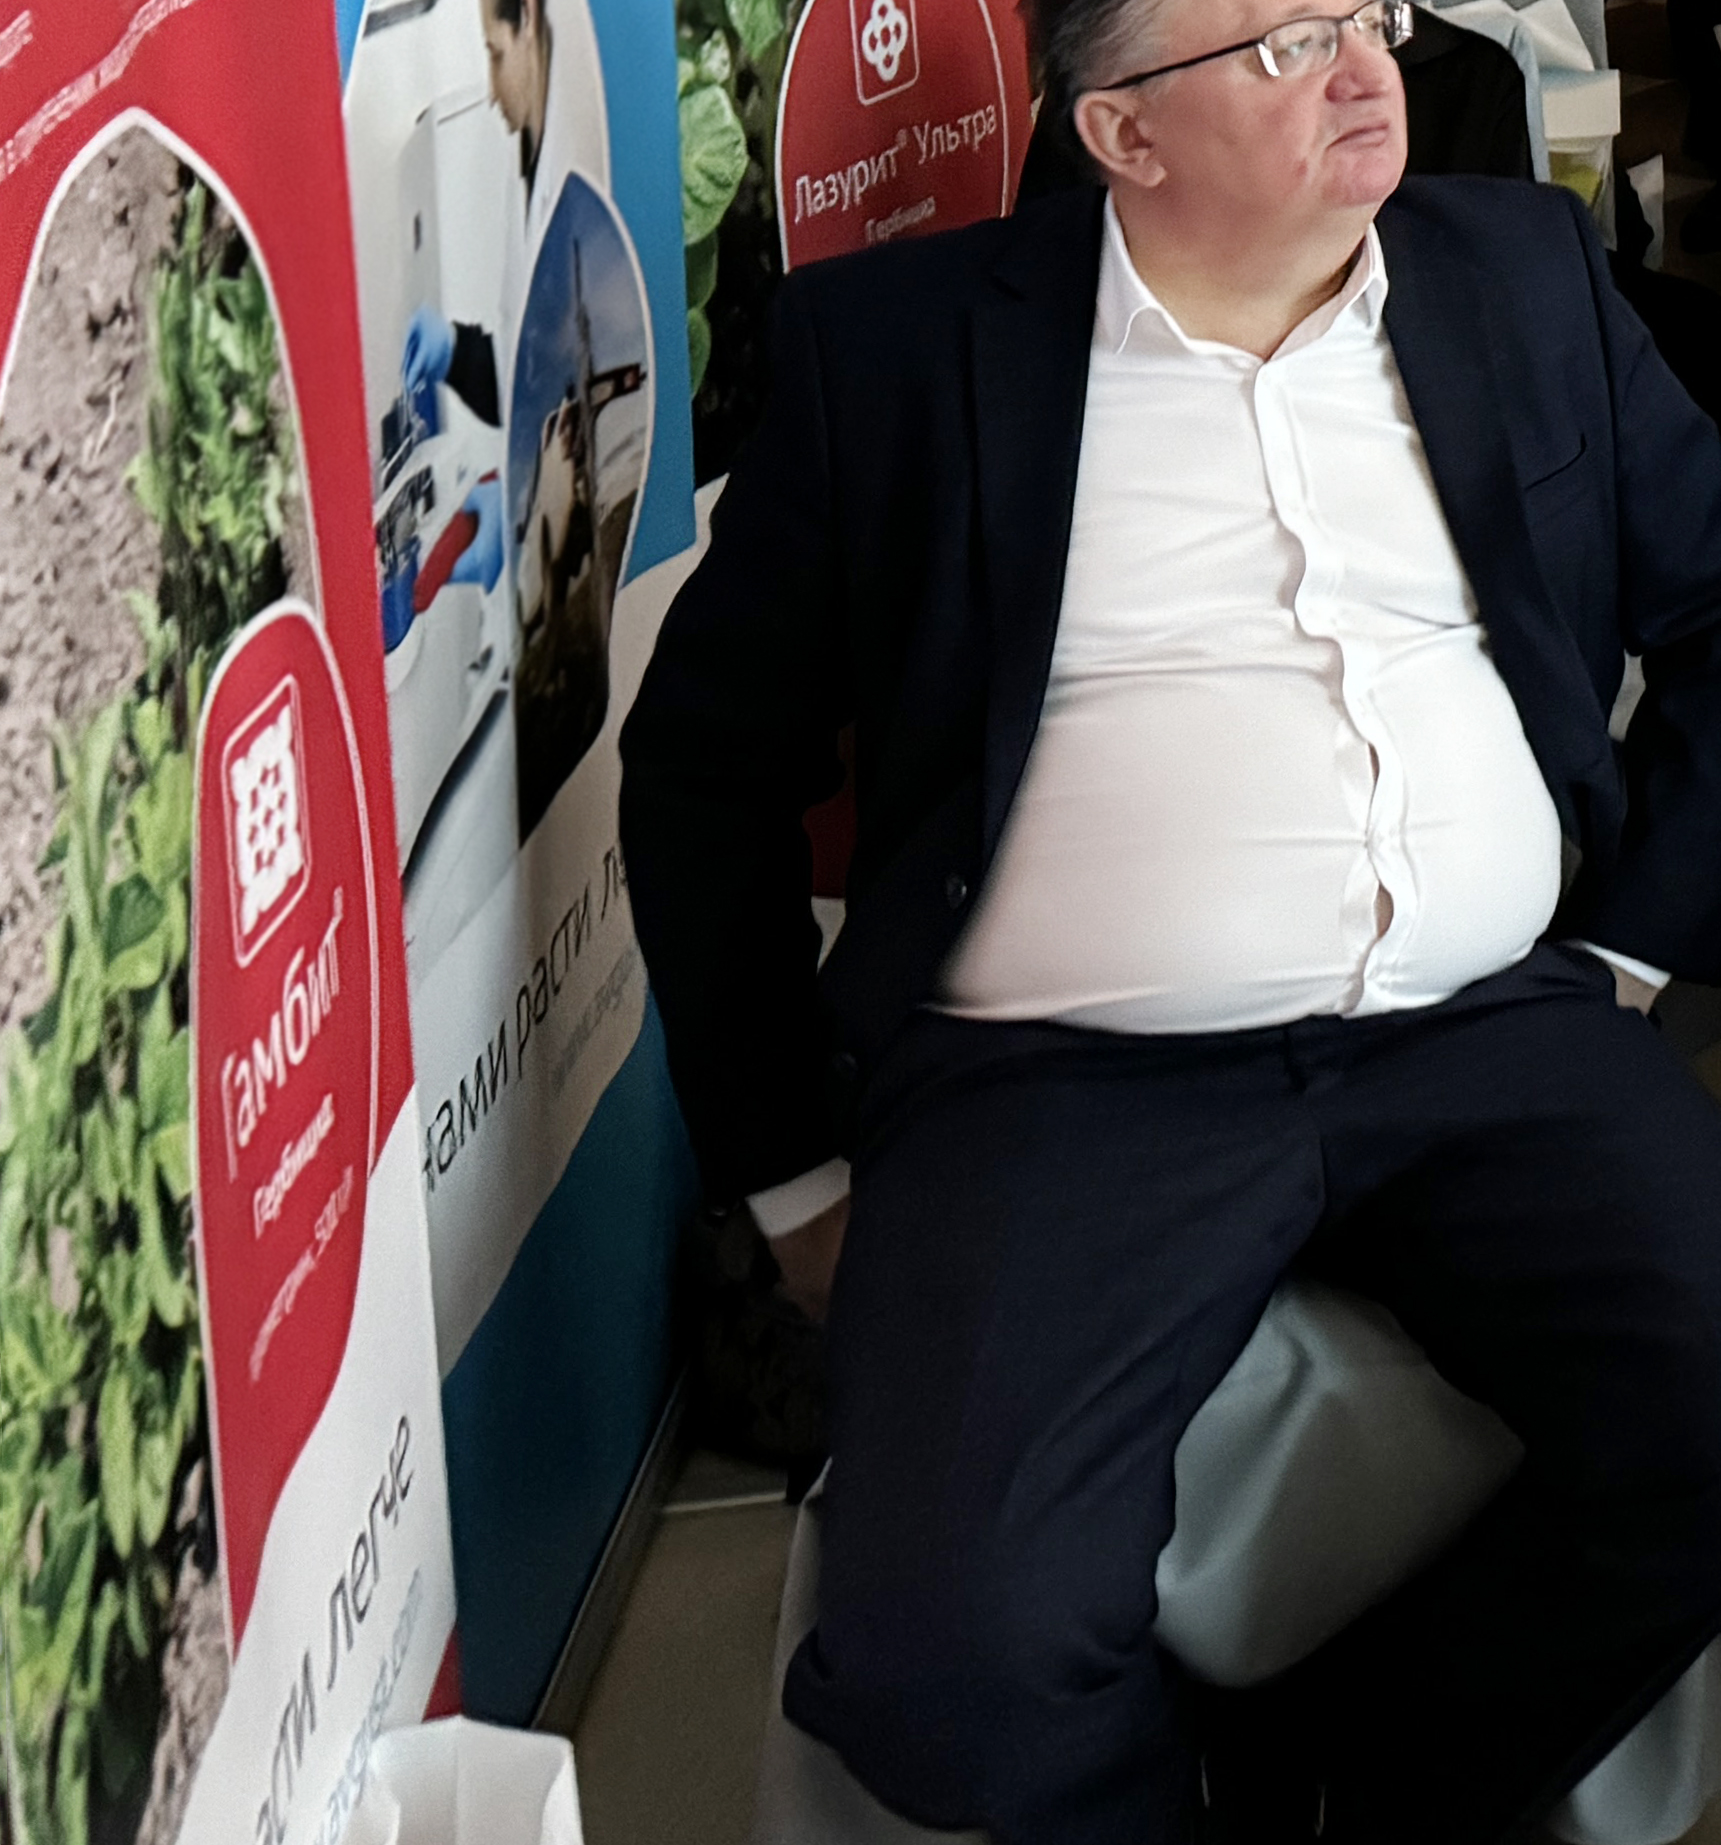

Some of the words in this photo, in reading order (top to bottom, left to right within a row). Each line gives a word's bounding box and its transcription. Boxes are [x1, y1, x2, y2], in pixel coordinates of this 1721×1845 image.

[794, 144, 902, 225] Лазурит
[912, 104, 998, 165] Ультра
[221, 913, 343, 1184] Гамбит
[516, 878, 592, 1081] расти
[326, 1414, 415, 1694] легче
